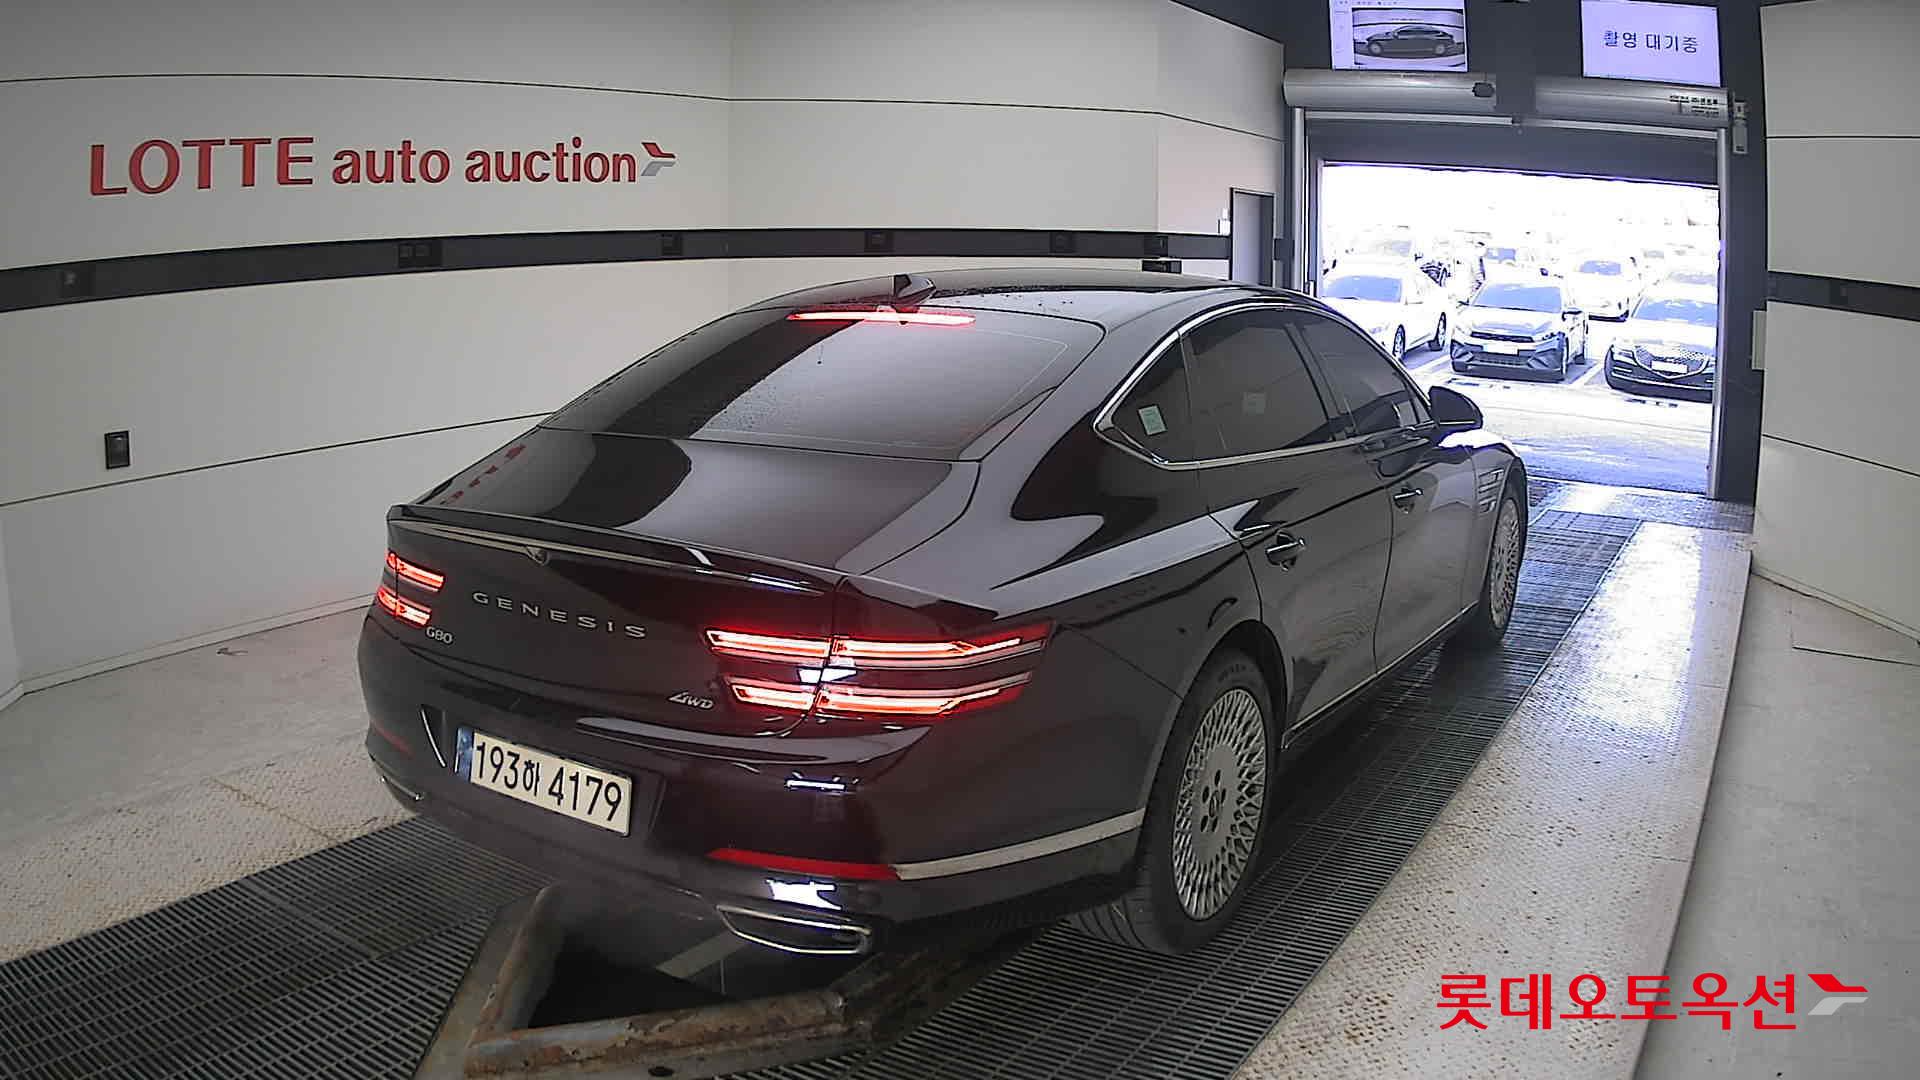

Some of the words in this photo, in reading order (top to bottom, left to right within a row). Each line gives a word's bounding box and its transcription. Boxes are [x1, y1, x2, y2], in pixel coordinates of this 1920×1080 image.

[1645, 33, 1698, 53] 대기중
[90, 136, 314, 196] LOTTE
[332, 139, 451, 185] auto
[465, 136, 637, 183] auction
[426, 626, 453, 644] G80
[472, 591, 647, 639] GENESIS
[476, 741, 541, 797] 193하
[548, 766, 623, 822] 4179
